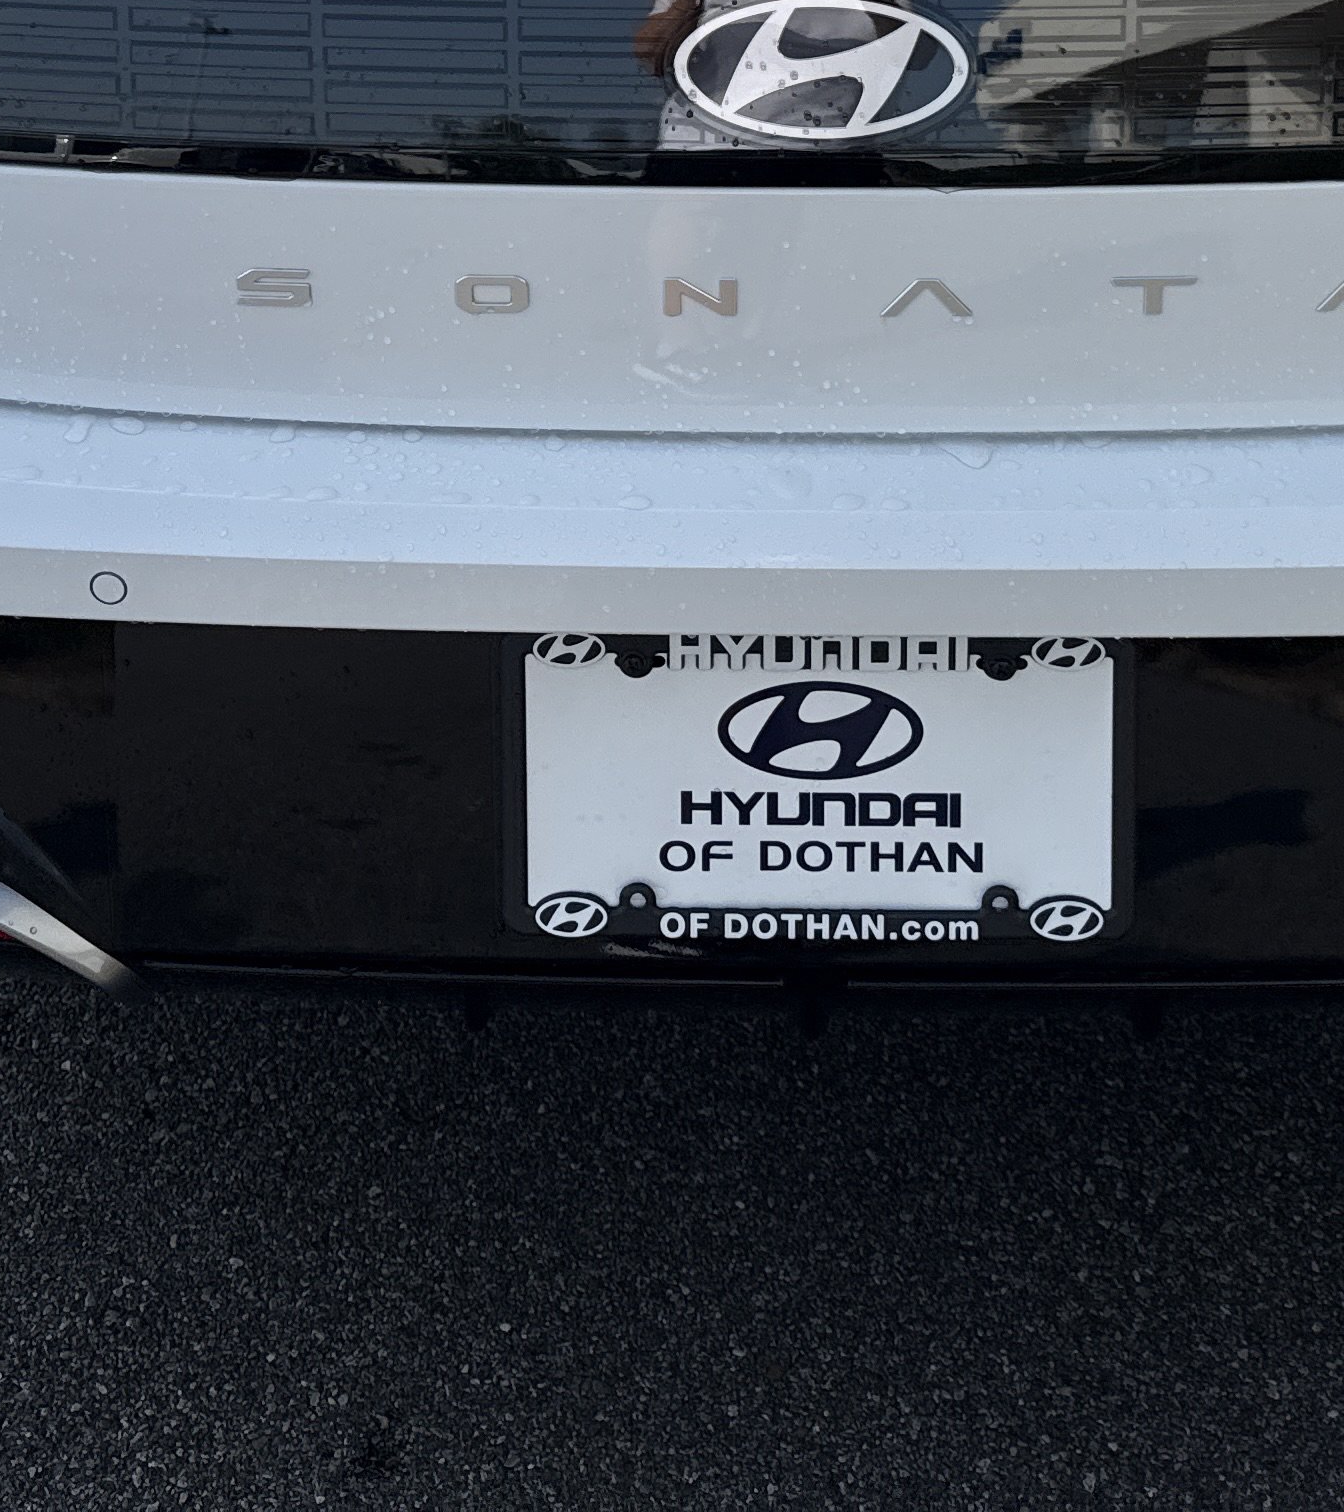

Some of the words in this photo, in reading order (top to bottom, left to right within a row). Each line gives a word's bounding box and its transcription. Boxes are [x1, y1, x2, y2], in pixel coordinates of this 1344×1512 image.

[668, 635, 969, 671] HYUNDAI
[679, 789, 962, 828] HYUNDAI
[658, 840, 734, 873] OF
[759, 840, 984, 874] DOTHAN
[659, 911, 711, 940] OF
[723, 913, 980, 941] DOTHAN.com
